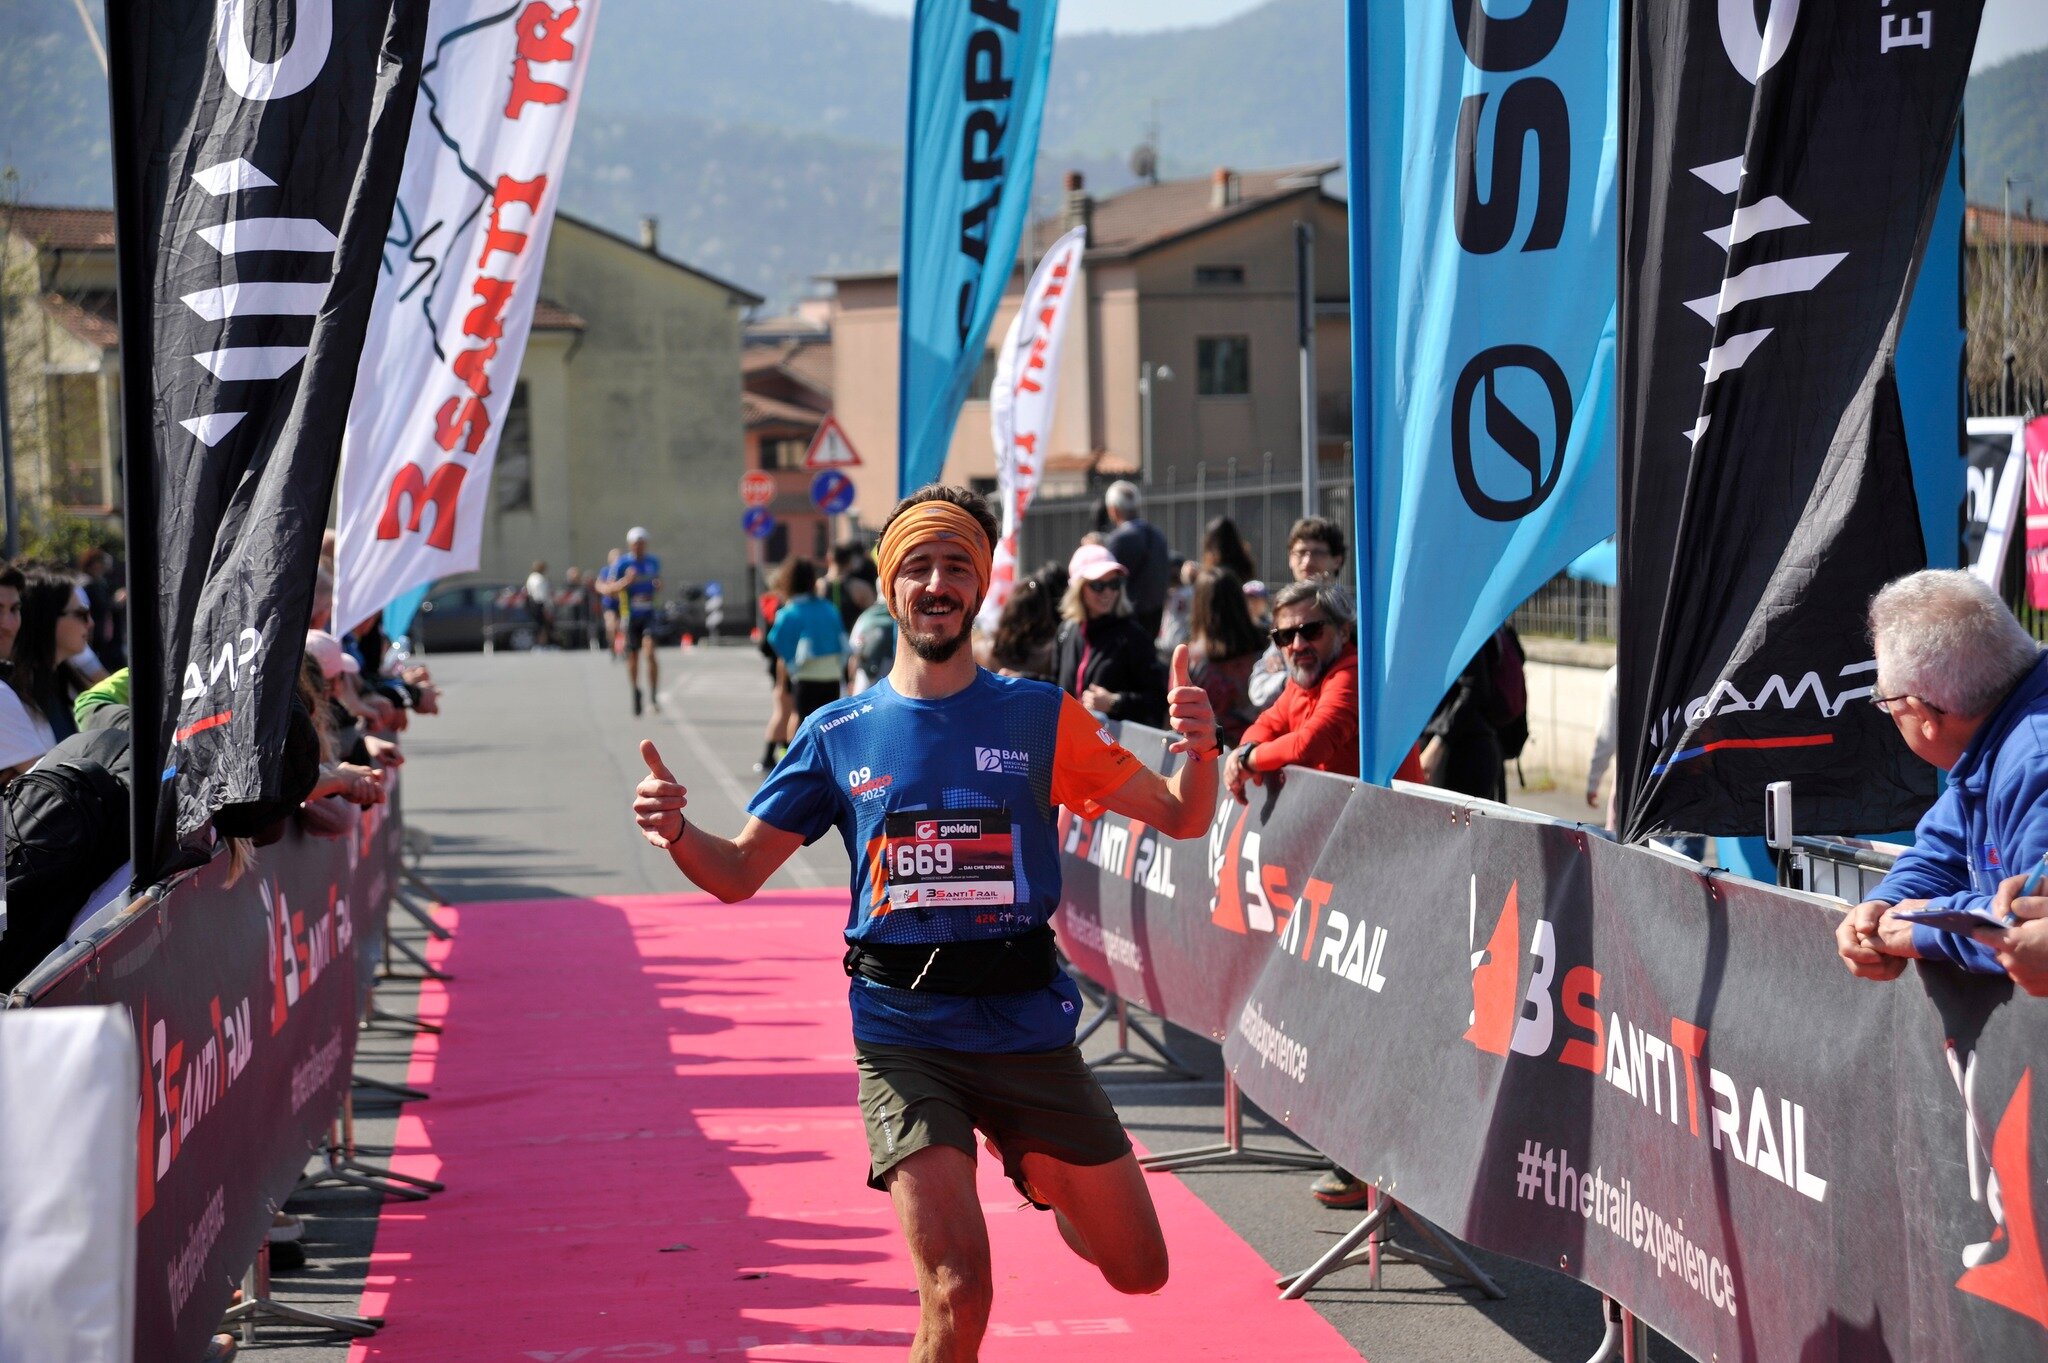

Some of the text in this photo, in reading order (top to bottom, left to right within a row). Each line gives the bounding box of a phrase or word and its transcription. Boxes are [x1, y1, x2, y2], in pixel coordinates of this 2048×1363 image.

[504, 0, 580, 120] TR
[819, 709, 860, 733] luanvi
[1002, 749, 1029, 762] BAM
[848, 766, 871, 788] 09
[860, 785, 886, 802] 2025
[897, 843, 953, 877] 669
[879, 1105, 894, 1152] SALOMON
[1516, 1139, 1738, 1318] #thetrailexperience
